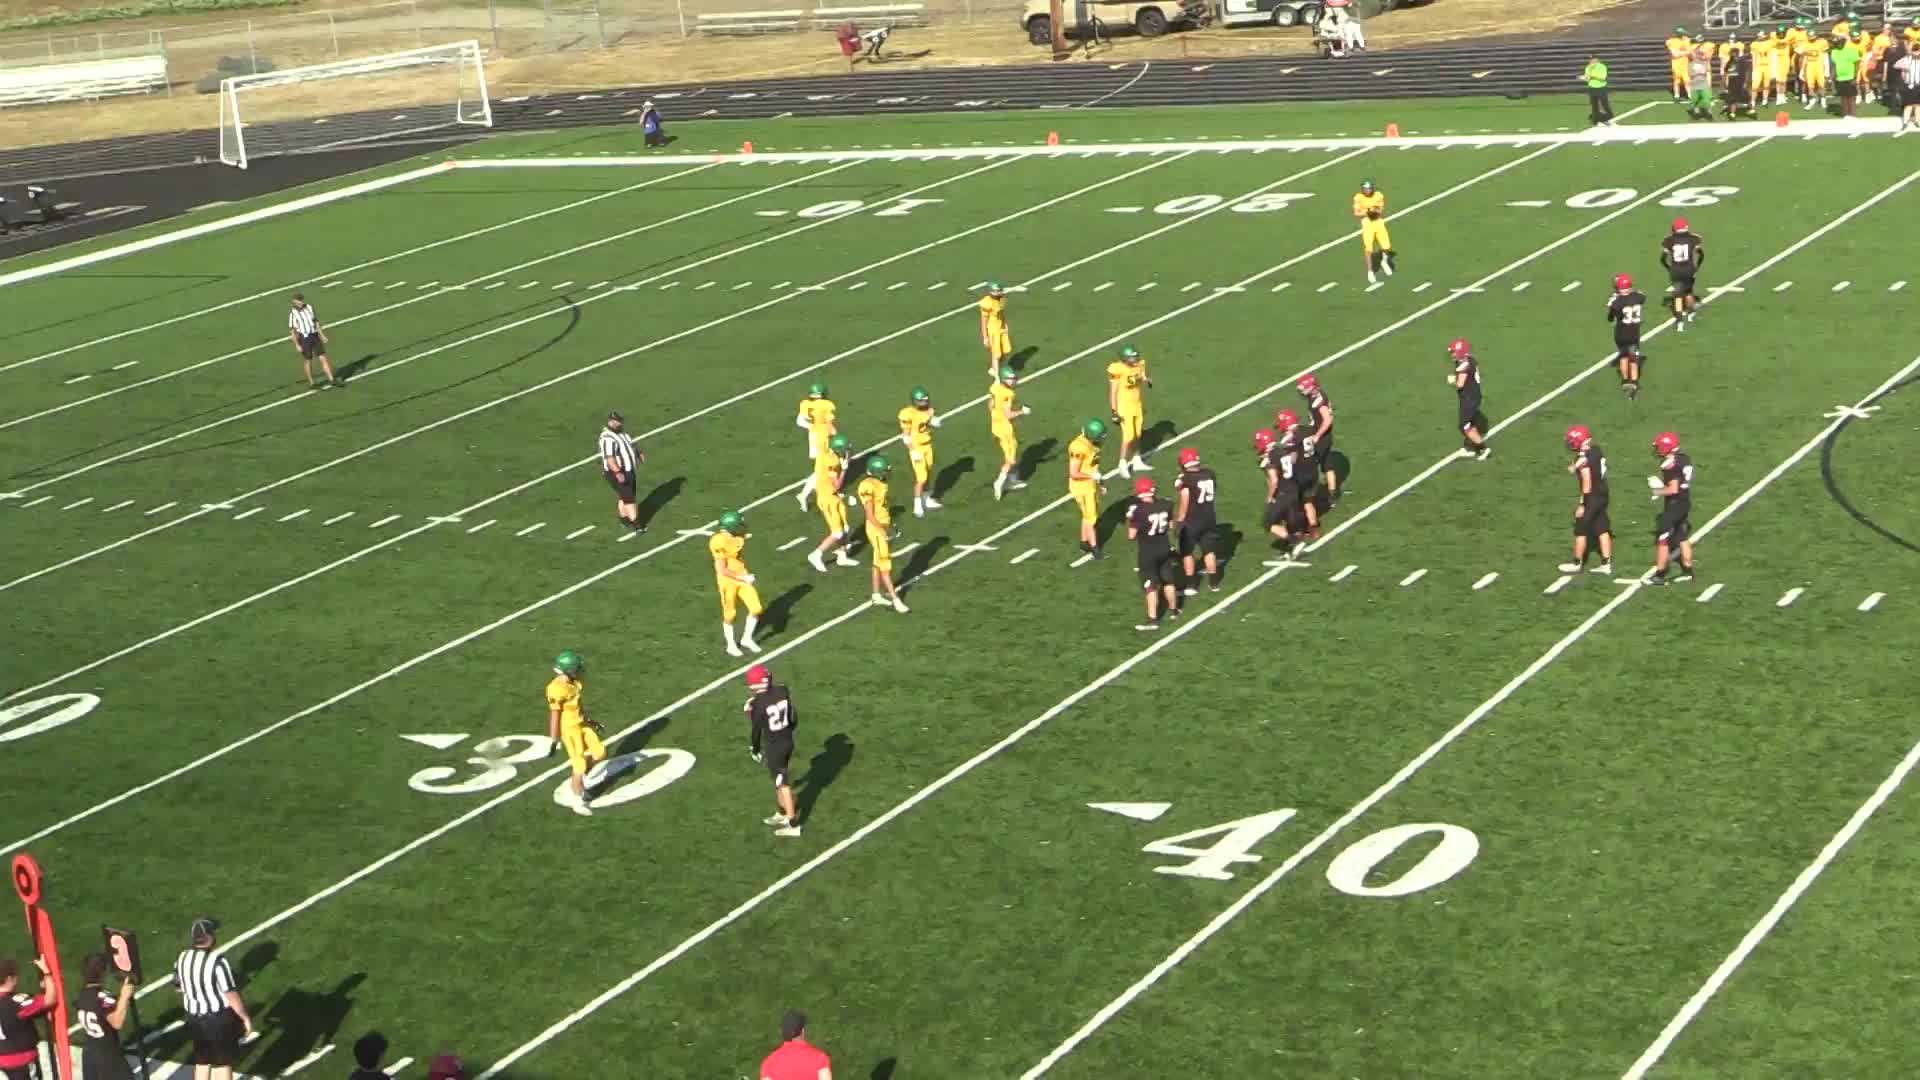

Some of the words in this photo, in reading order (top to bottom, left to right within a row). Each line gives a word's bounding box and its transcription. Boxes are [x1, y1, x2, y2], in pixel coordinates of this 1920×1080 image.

[1672, 244, 1689, 262] 21
[1622, 304, 1641, 324] 33
[1197, 479, 1214, 504] 79
[766, 699, 789, 732] 27
[407, 734, 697, 809] 30
[1142, 808, 1481, 897] 40
[110, 934, 132, 972] 3
